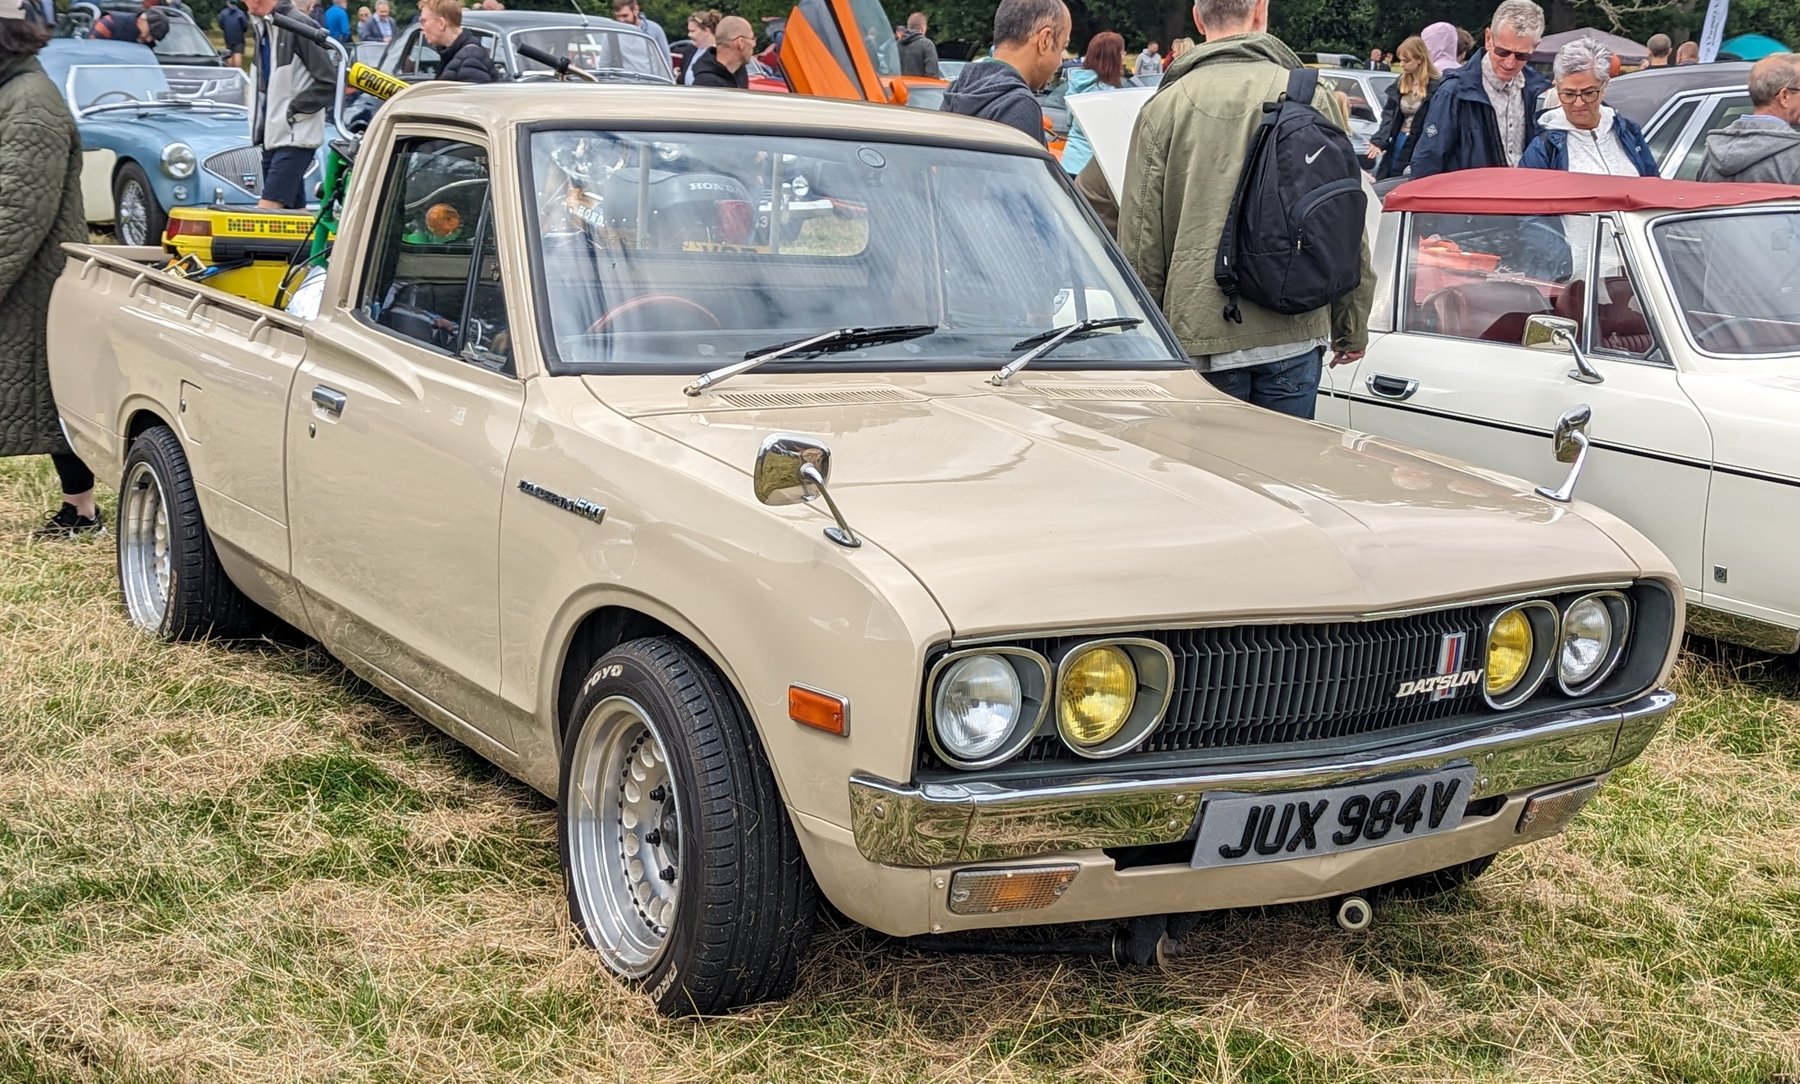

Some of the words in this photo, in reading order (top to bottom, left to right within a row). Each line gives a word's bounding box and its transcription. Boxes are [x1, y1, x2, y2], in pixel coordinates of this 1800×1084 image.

[689, 182, 744, 196] HONDA
[583, 664, 624, 695] TOYO
[1394, 668, 1484, 698] DATSUN
[1218, 799, 1329, 859] JUX
[1332, 778, 1461, 846] 984V
